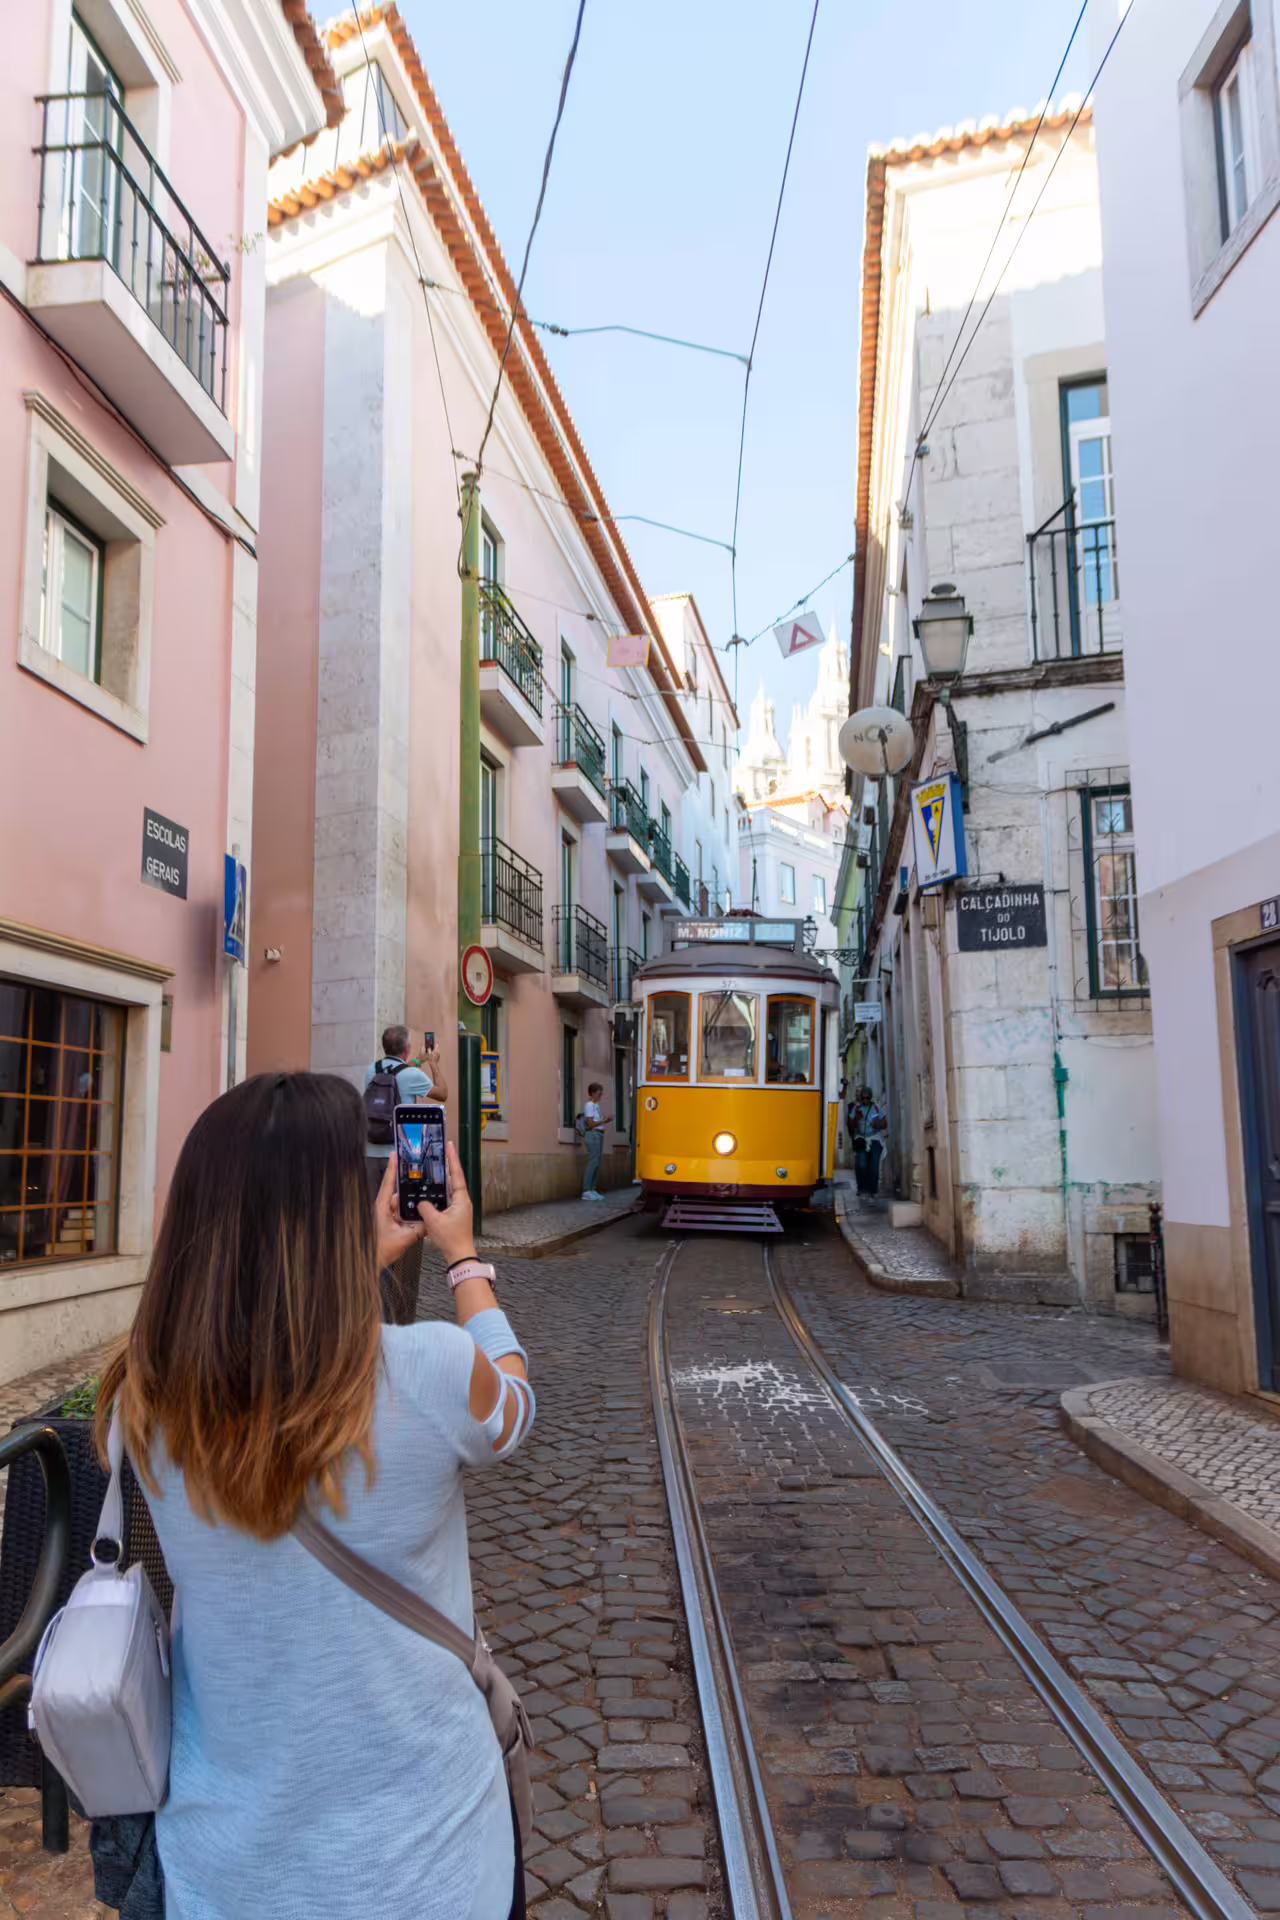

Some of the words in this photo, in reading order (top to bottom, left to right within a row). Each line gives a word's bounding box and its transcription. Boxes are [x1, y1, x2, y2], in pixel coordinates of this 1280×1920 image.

[146, 819, 186, 853] ESCOLAS
[146, 856, 180, 886] GERAIS
[960, 892, 1039, 913] CALÇADINHA
[997, 913, 1010, 923] DO
[697, 927, 743, 939] MONIZ
[980, 925, 1026, 942] TIJOLO
